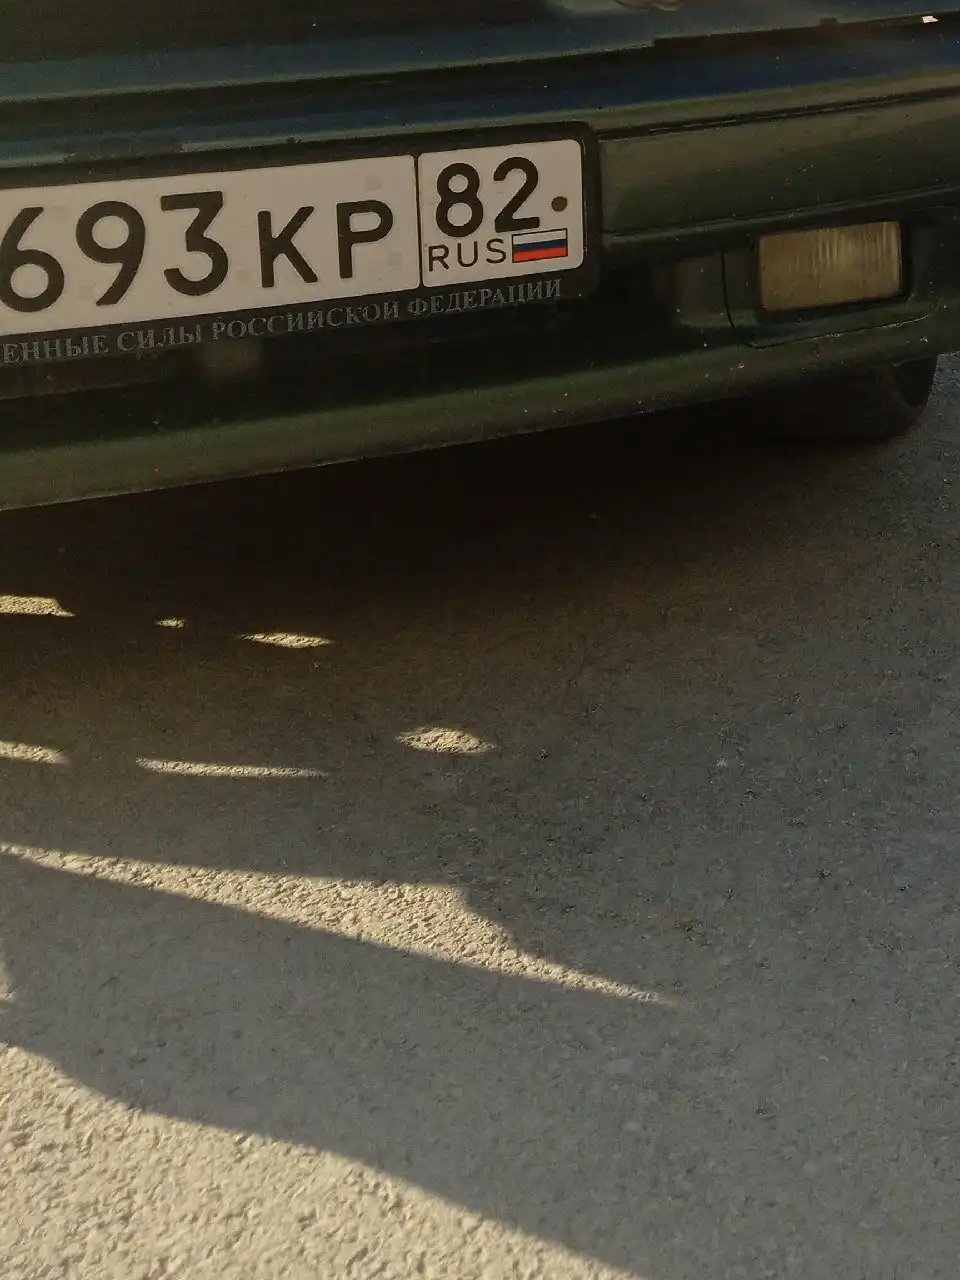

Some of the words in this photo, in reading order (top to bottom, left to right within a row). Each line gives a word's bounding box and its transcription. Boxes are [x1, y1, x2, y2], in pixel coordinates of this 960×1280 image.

[435, 156, 541, 238] 82
[428, 237, 507, 272] RUS
[117, 324, 201, 354] СИЛЫ
[407, 277, 562, 317] ФЕДЕРАЦИИ
